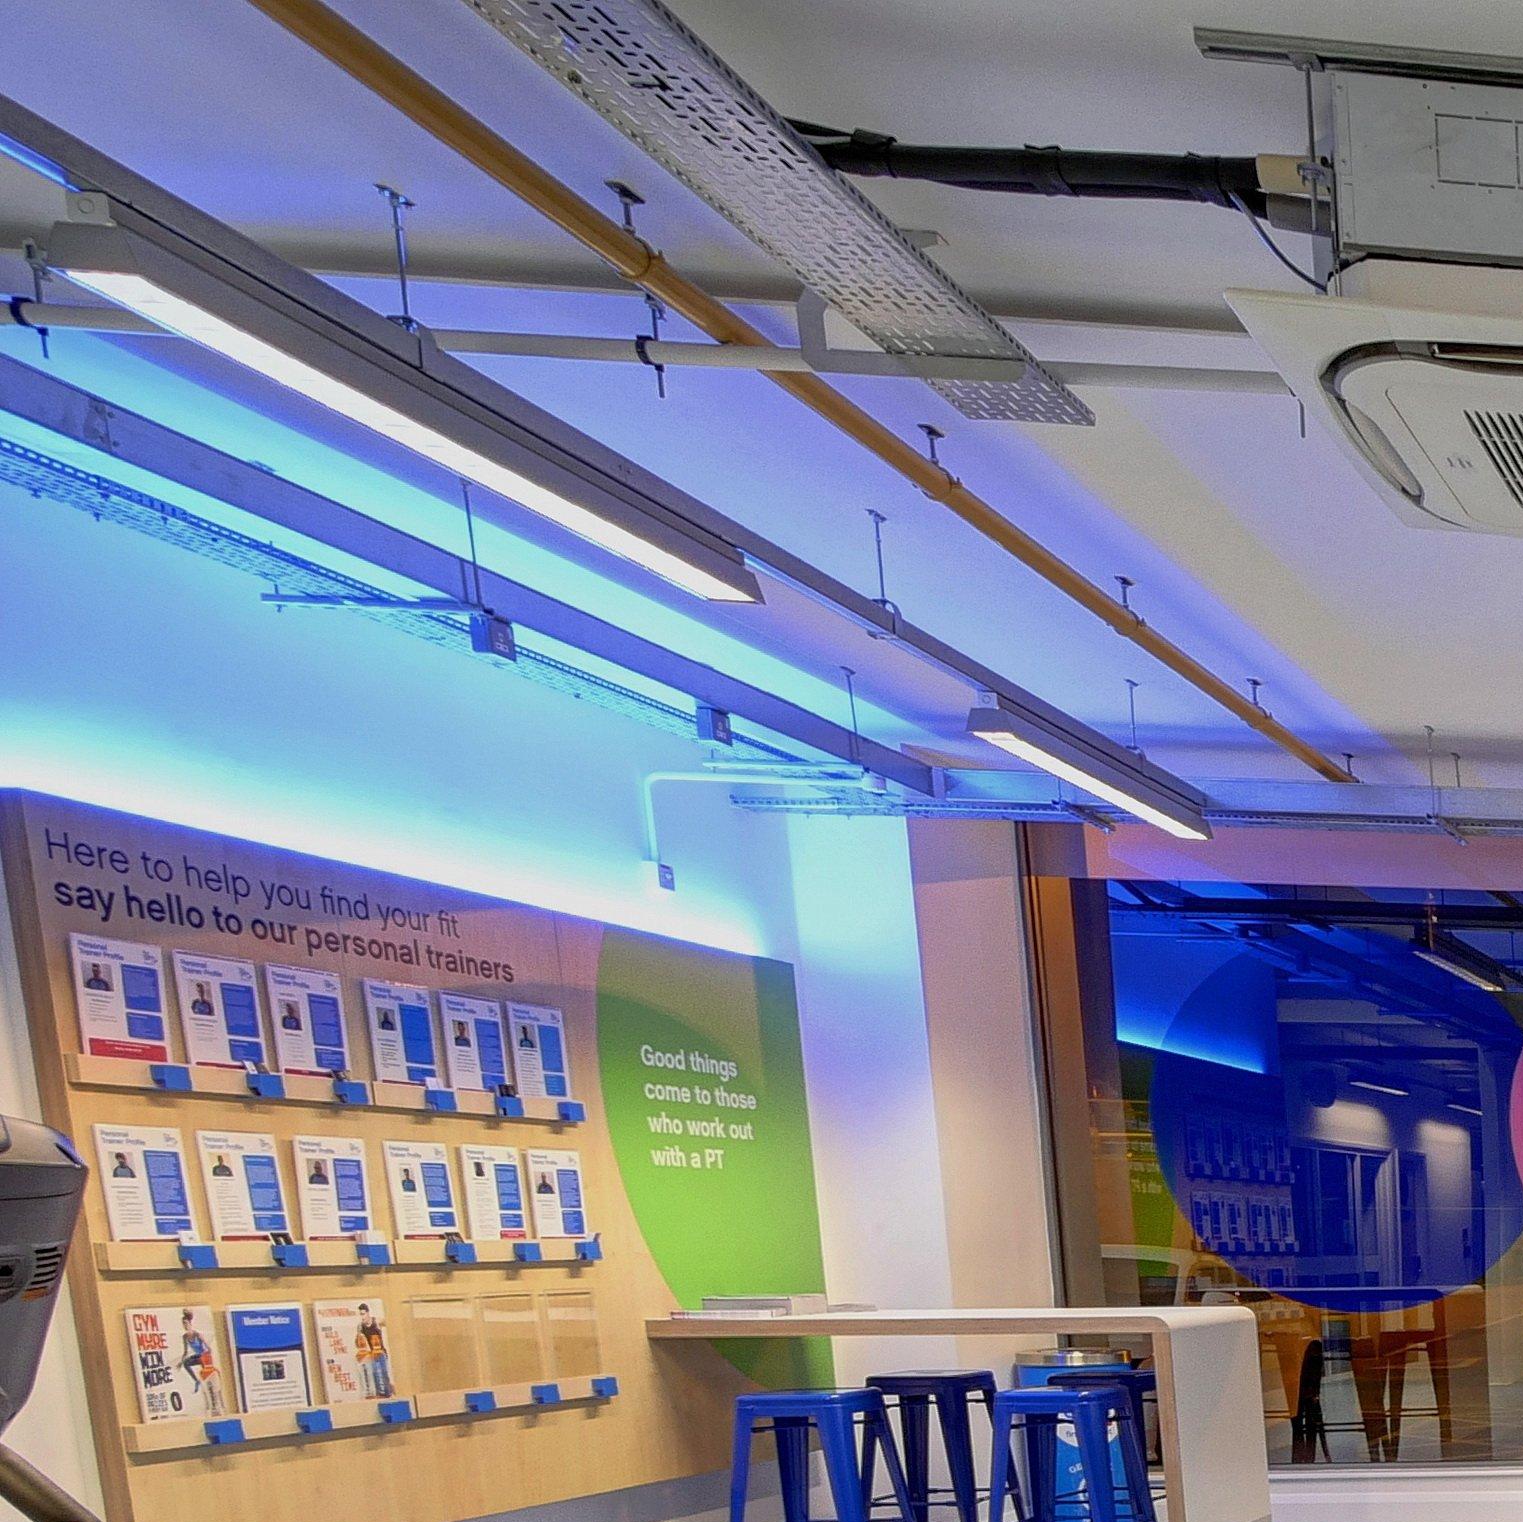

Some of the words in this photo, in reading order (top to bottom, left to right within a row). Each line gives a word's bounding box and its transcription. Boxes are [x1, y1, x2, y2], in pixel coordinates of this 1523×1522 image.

[45, 828, 129, 874] Here
[140, 851, 173, 883] to
[183, 855, 250, 905] help
[260, 880, 311, 911] you
[320, 886, 370, 921] find
[377, 903, 430, 932] your
[438, 910, 461, 939] fit
[54, 881, 115, 922] say
[123, 885, 205, 928] hello
[212, 905, 243, 935] to
[252, 918, 297, 945] our
[304, 926, 421, 966] personal
[427, 945, 514, 982] trainers
[640, 1044, 686, 1070] Good
[689, 1051, 738, 1081] things
[644, 1083, 691, 1103] come
[694, 1086, 711, 1105] to
[714, 1086, 757, 1110] those
[647, 1112, 683, 1134] who
[686, 1117, 726, 1138] work
[729, 1122, 754, 1140] out
[651, 1145, 687, 1167] with
[690, 1152, 701, 1168] a
[704, 1149, 724, 1169] PT
[133, 1314, 159, 1332] GYM
[139, 1350, 165, 1369] WIN
[143, 1366, 173, 1389] MORE
